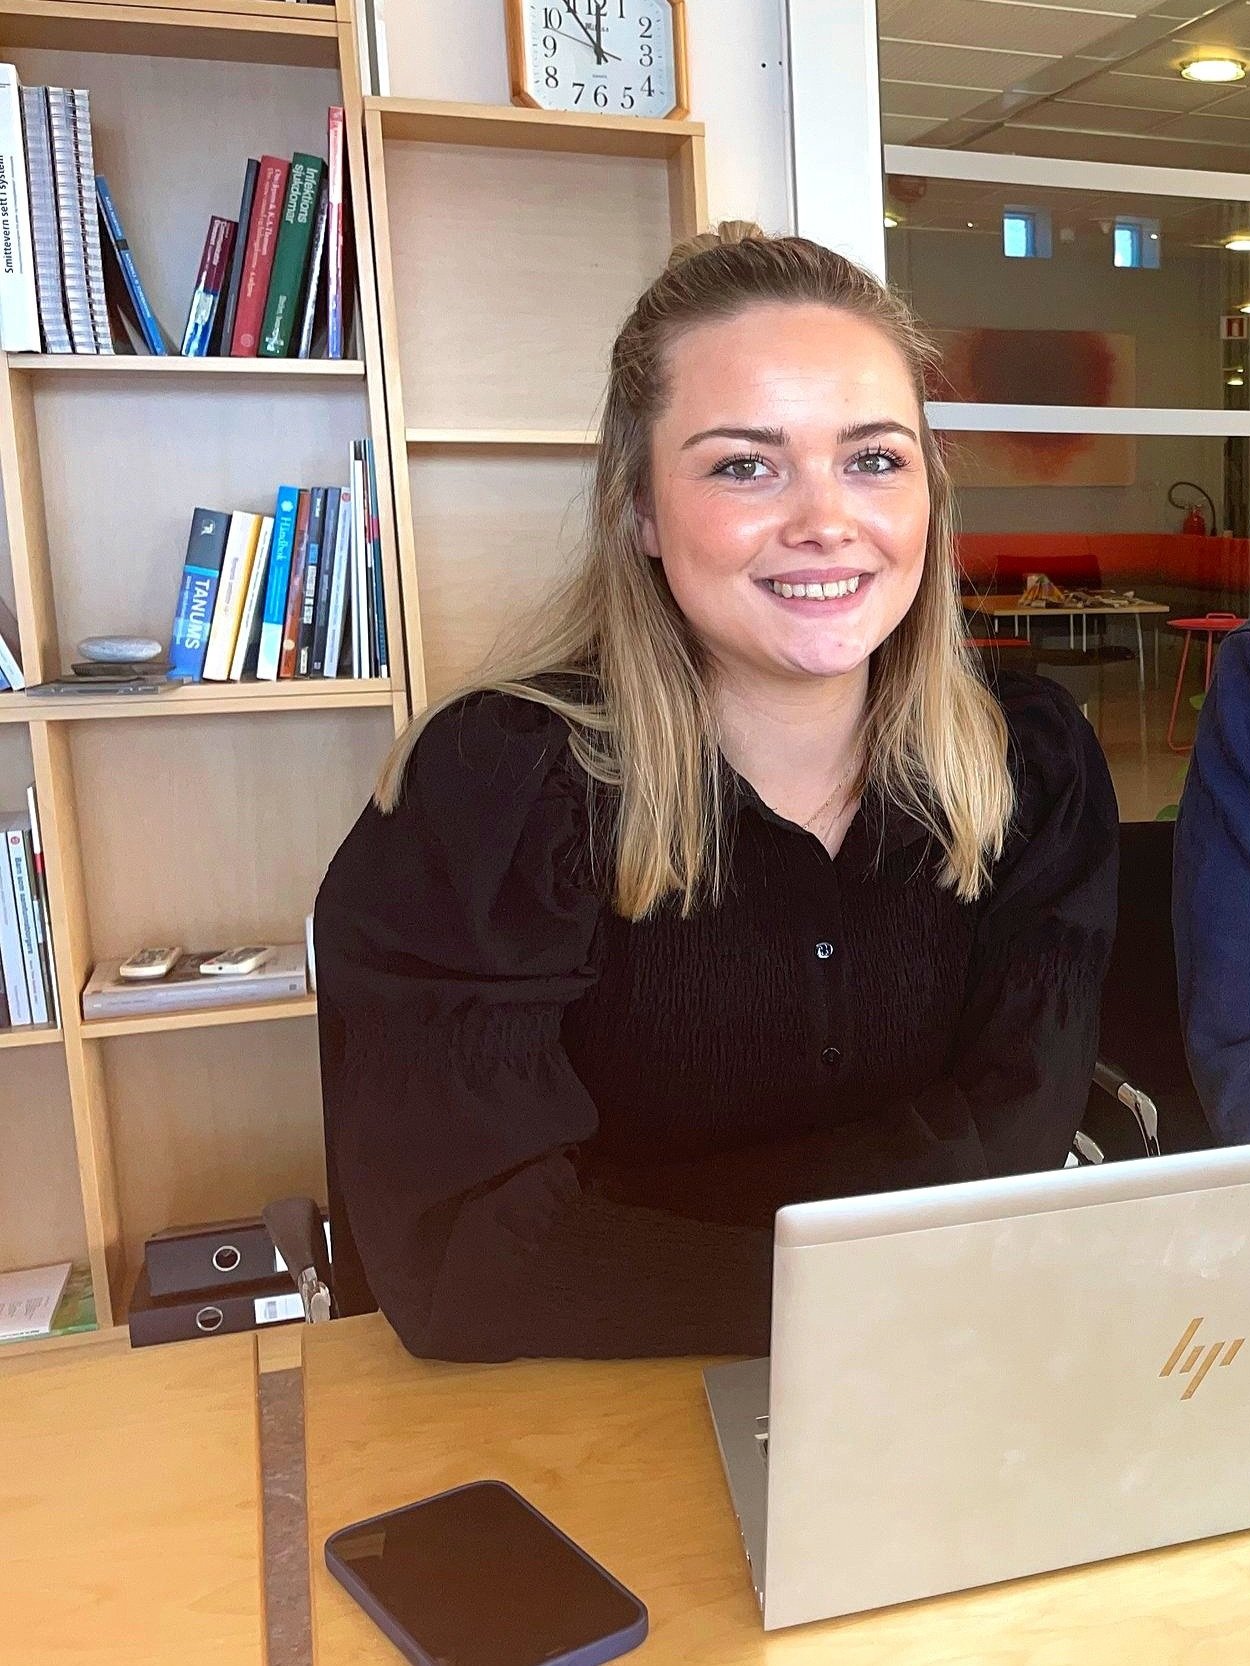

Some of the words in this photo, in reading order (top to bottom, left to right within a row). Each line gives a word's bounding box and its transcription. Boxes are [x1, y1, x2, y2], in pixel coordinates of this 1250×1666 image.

[542, 8, 562, 30] 10
[639, 17, 653, 39] 2
[543, 35, 557, 58] 9
[639, 45, 653, 67] 3
[545, 66, 559, 89] 8
[641, 75, 655, 97] 4
[572, 83, 585, 105] 7
[593, 85, 608, 108] 6
[620, 87, 635, 110] 5
[285, 163, 306, 225] sjukdomar
[297, 167, 318, 224] Infektions
[2, 219, 14, 274] Smittevern
[184, 578, 210, 650] TANUMS
[1158, 1316, 1246, 1401] hp
